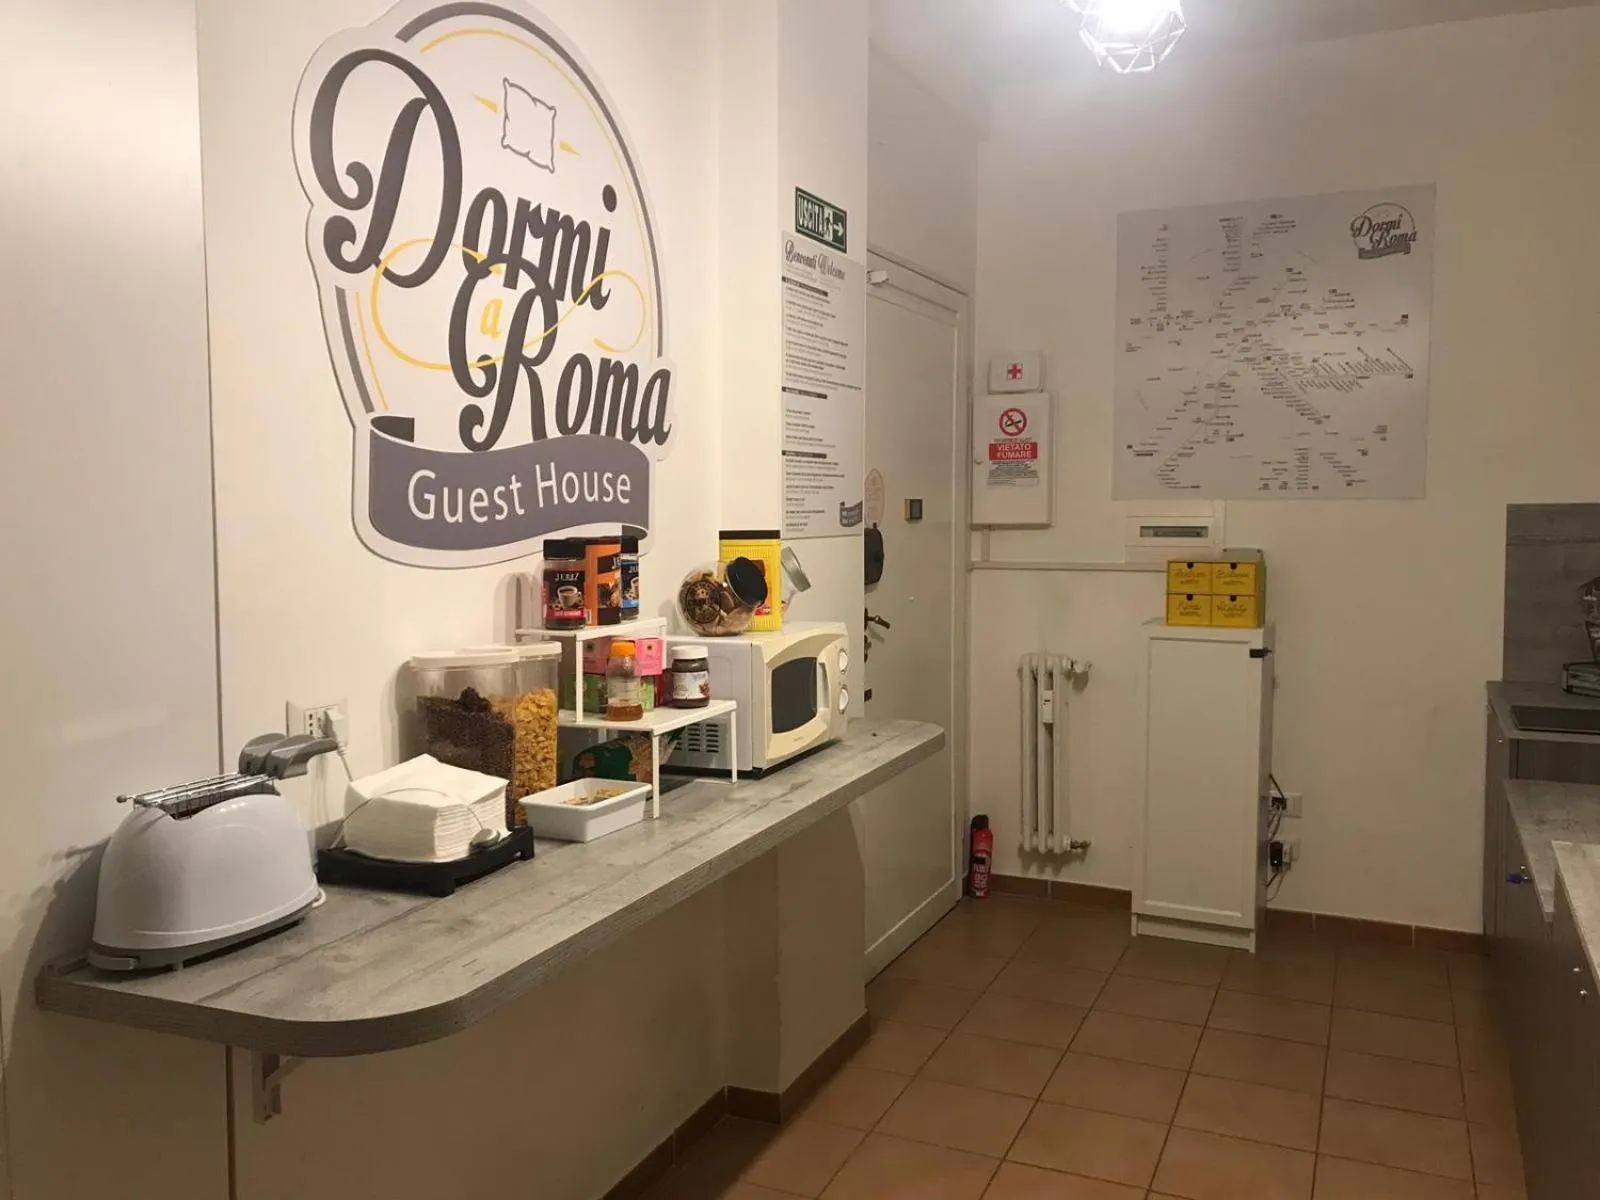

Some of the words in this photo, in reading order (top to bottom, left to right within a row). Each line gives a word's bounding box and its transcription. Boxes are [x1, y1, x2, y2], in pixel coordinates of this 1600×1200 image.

[310, 48, 618, 310] Dormi
[798, 196, 824, 235] USCITA
[1350, 213, 1403, 238] Dormi
[1369, 228, 1417, 248] Roma
[479, 298, 503, 338] a
[448, 253, 672, 453] Roma
[996, 451, 1032, 459] FUMARE
[997, 443, 1032, 451] VIETATO
[407, 469, 526, 523] Guest
[535, 461, 632, 508] House
